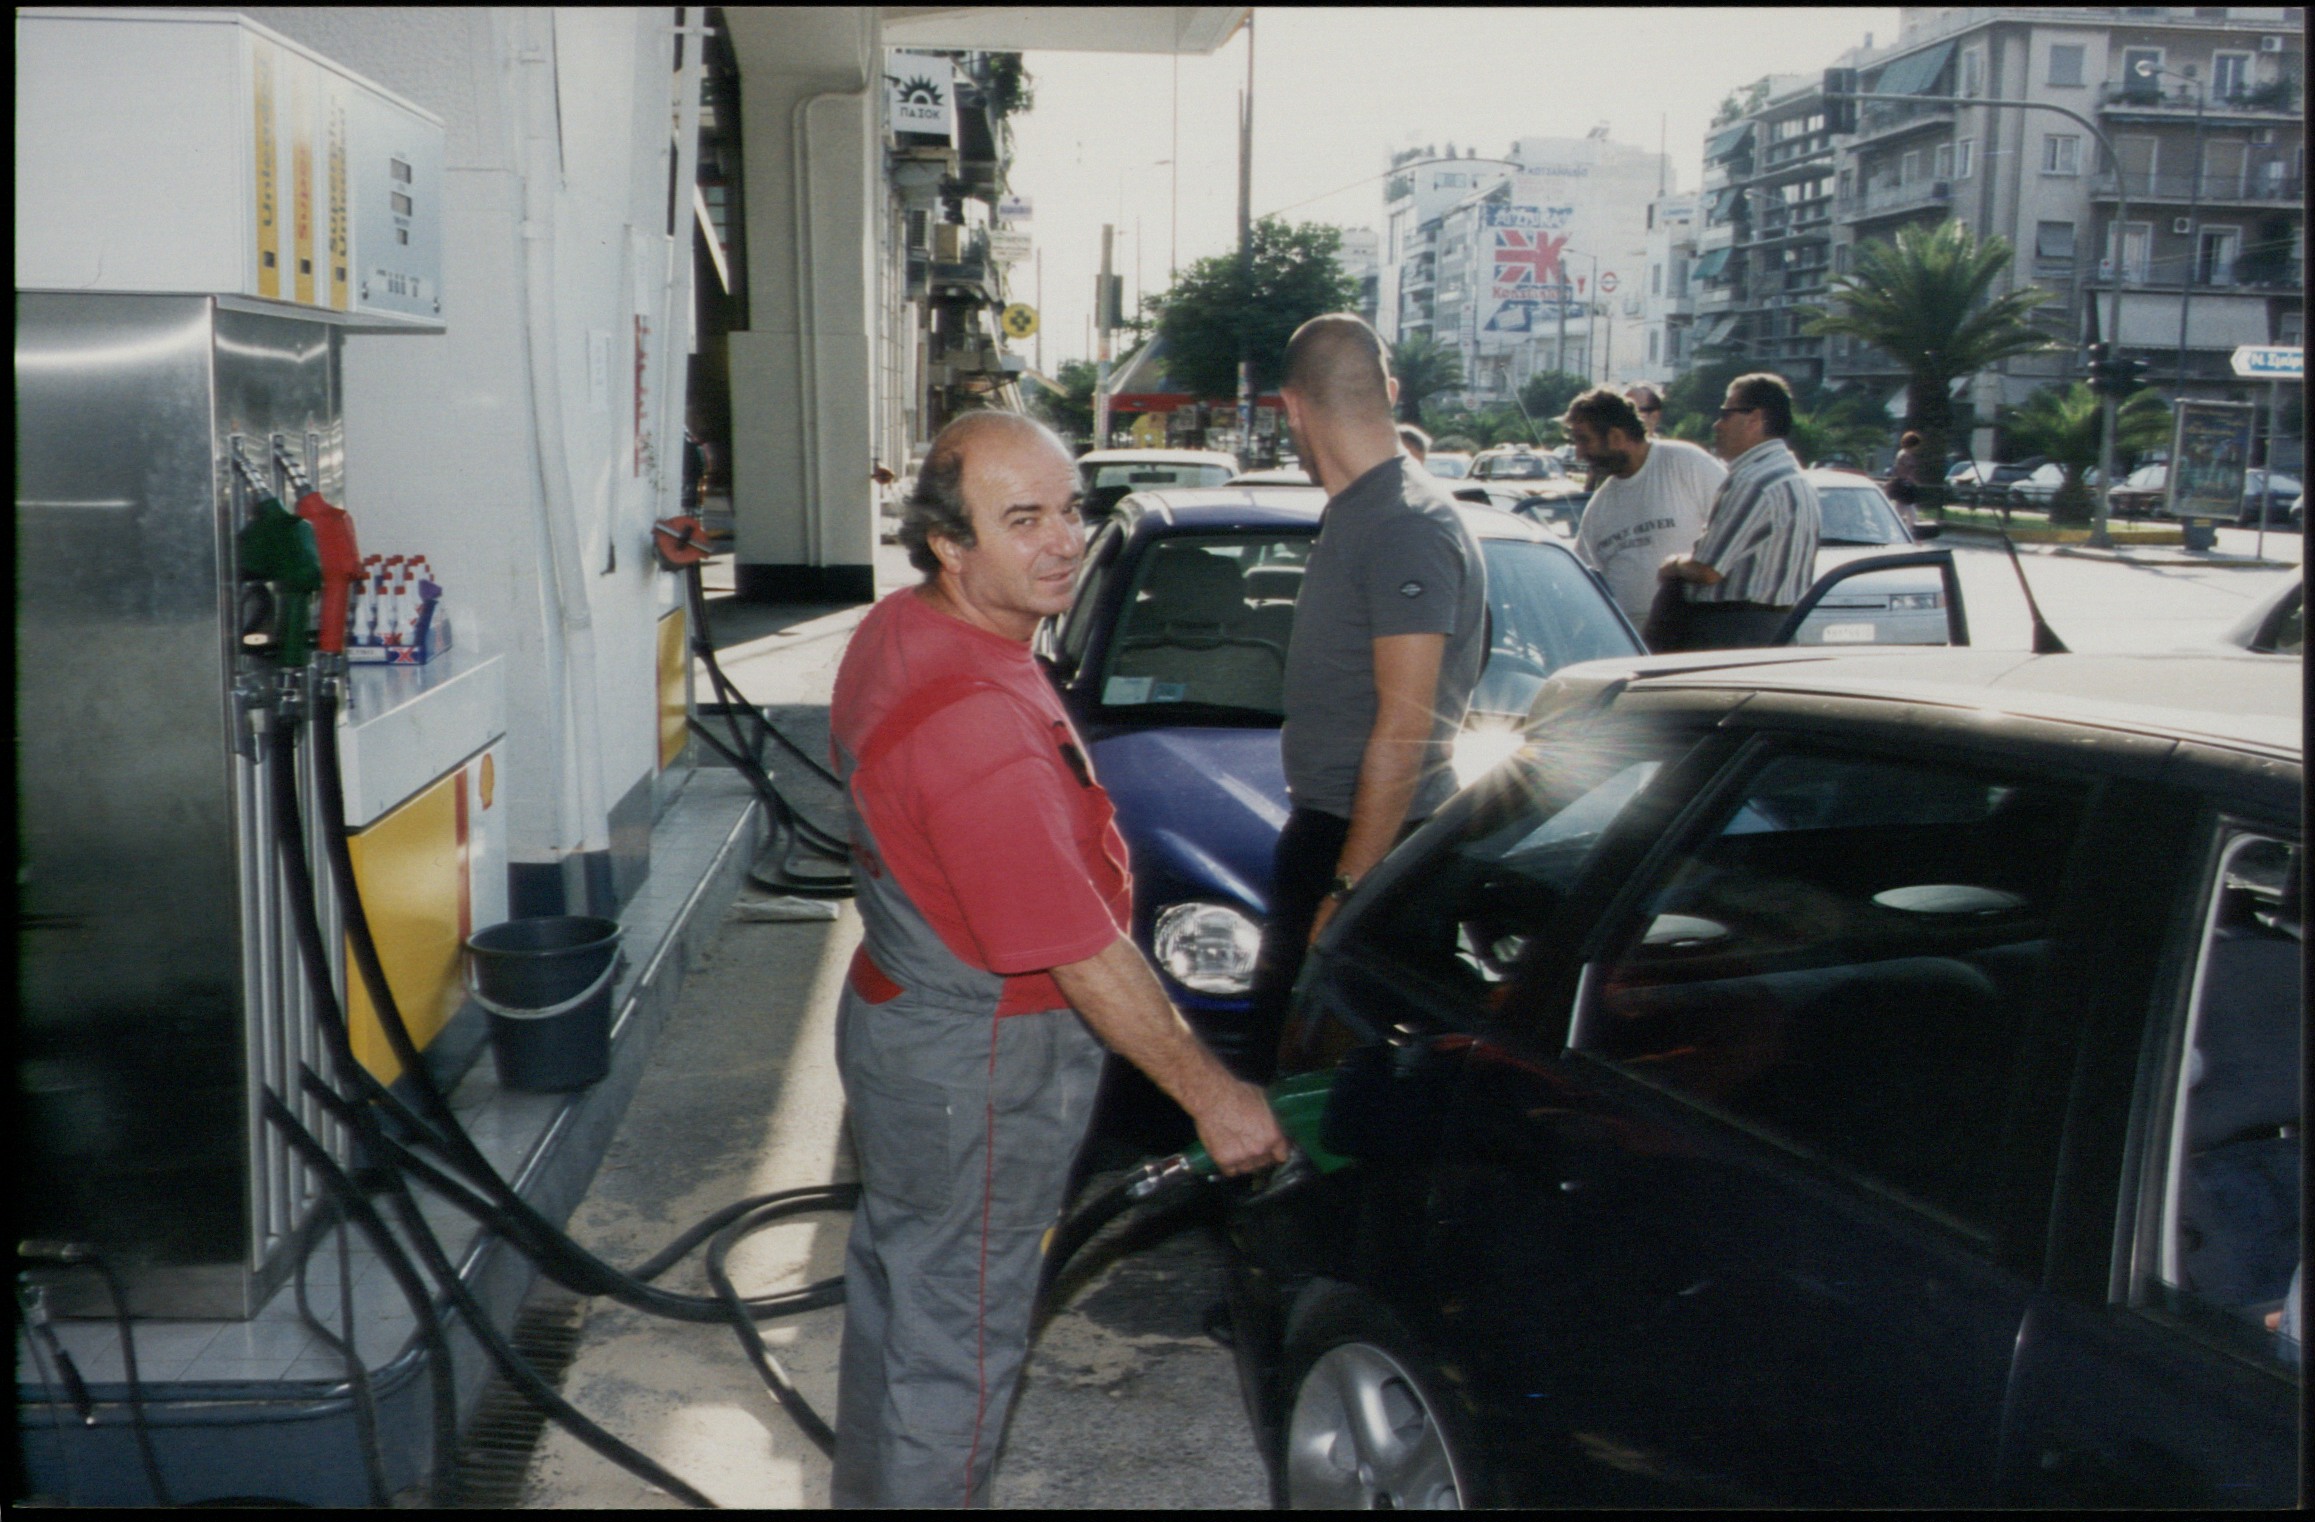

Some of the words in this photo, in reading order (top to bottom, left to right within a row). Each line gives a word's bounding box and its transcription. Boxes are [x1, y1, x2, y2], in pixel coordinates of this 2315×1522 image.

[900, 106, 940, 119] ΠΑΣΟΚ
[1493, 286, 1570, 300] Kensingto
[1633, 518, 1676, 534] OLIVER
